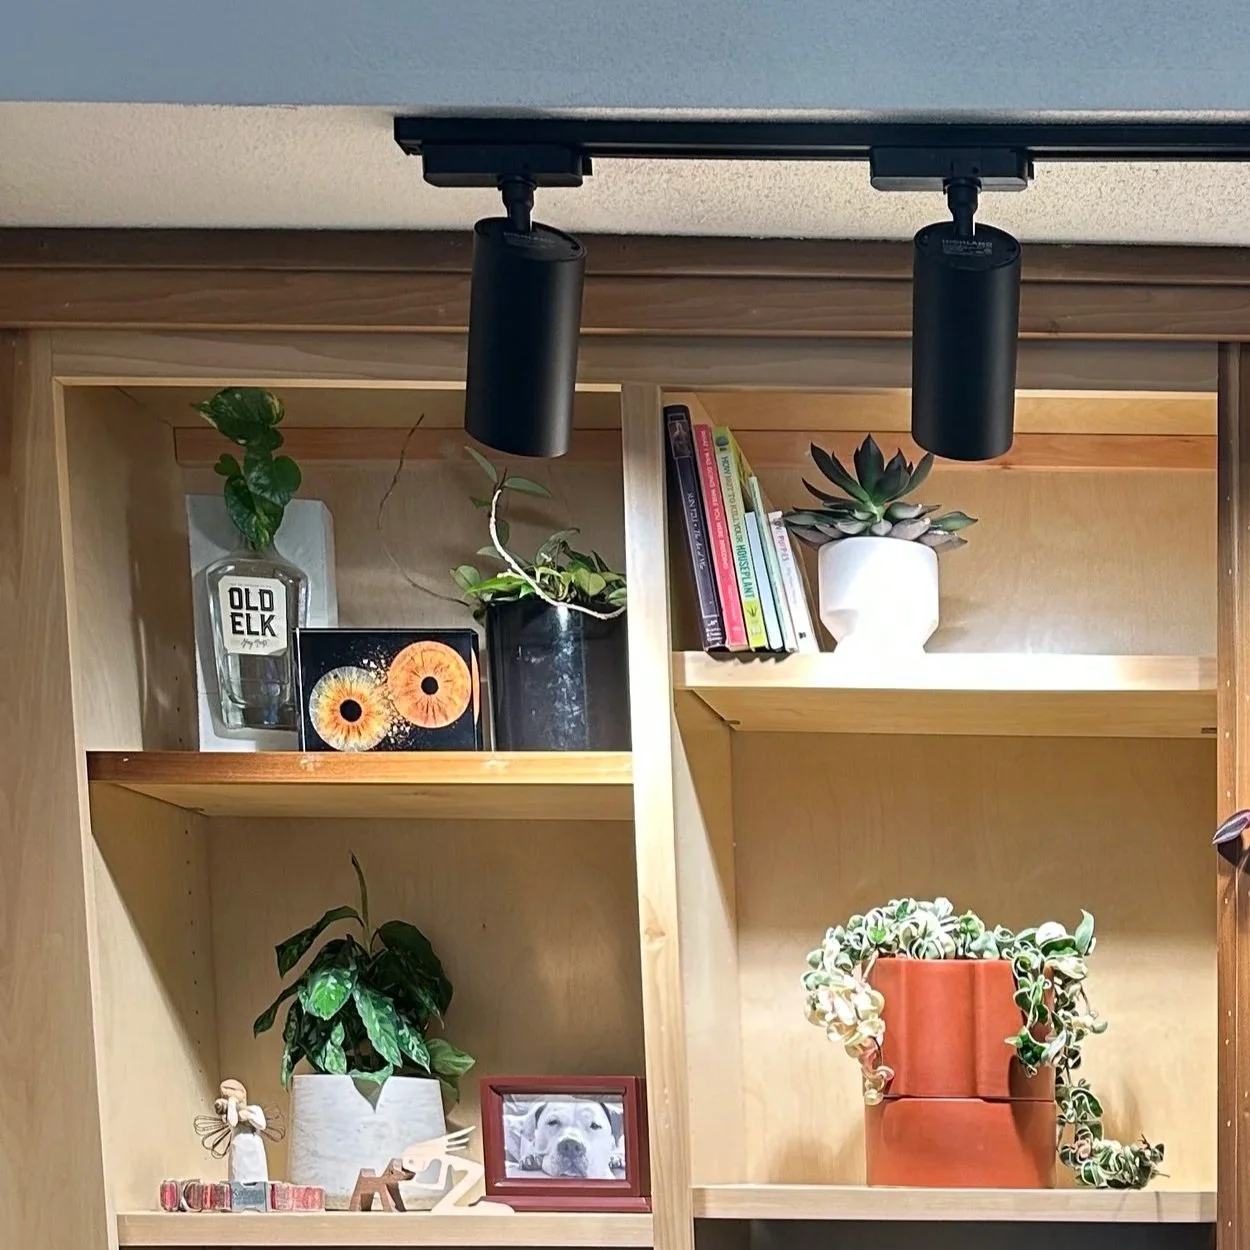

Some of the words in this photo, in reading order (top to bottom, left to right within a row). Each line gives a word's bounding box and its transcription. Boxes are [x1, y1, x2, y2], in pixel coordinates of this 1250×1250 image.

[721, 456, 730, 475] HOW
[736, 544, 755, 598] HOUSEPLANT
[228, 587, 274, 611] OLD
[230, 612, 277, 637] ELK
